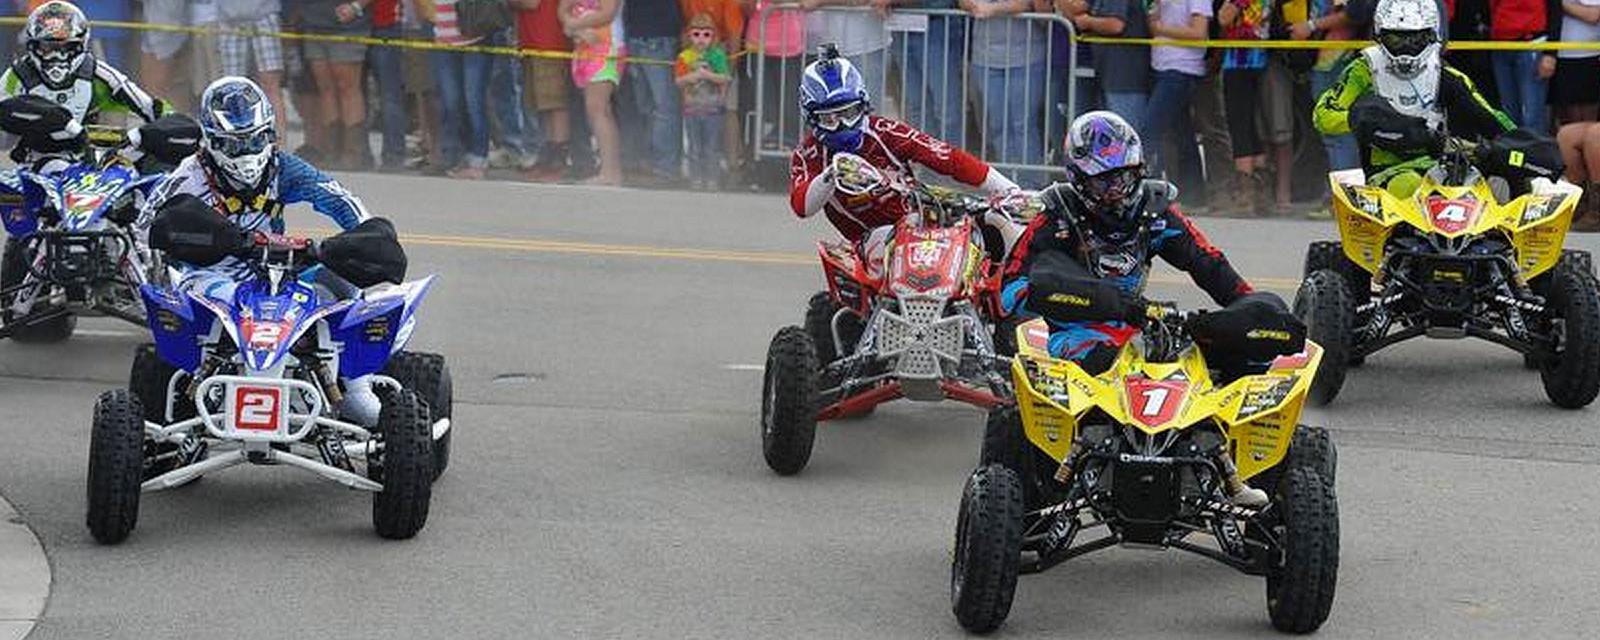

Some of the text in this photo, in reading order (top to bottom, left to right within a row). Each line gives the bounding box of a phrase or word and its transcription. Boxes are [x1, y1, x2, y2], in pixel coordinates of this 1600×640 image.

[1435, 204, 1467, 222] 4
[250, 321, 281, 341] 2
[240, 392, 275, 424] 2
[1141, 387, 1170, 416] 1
